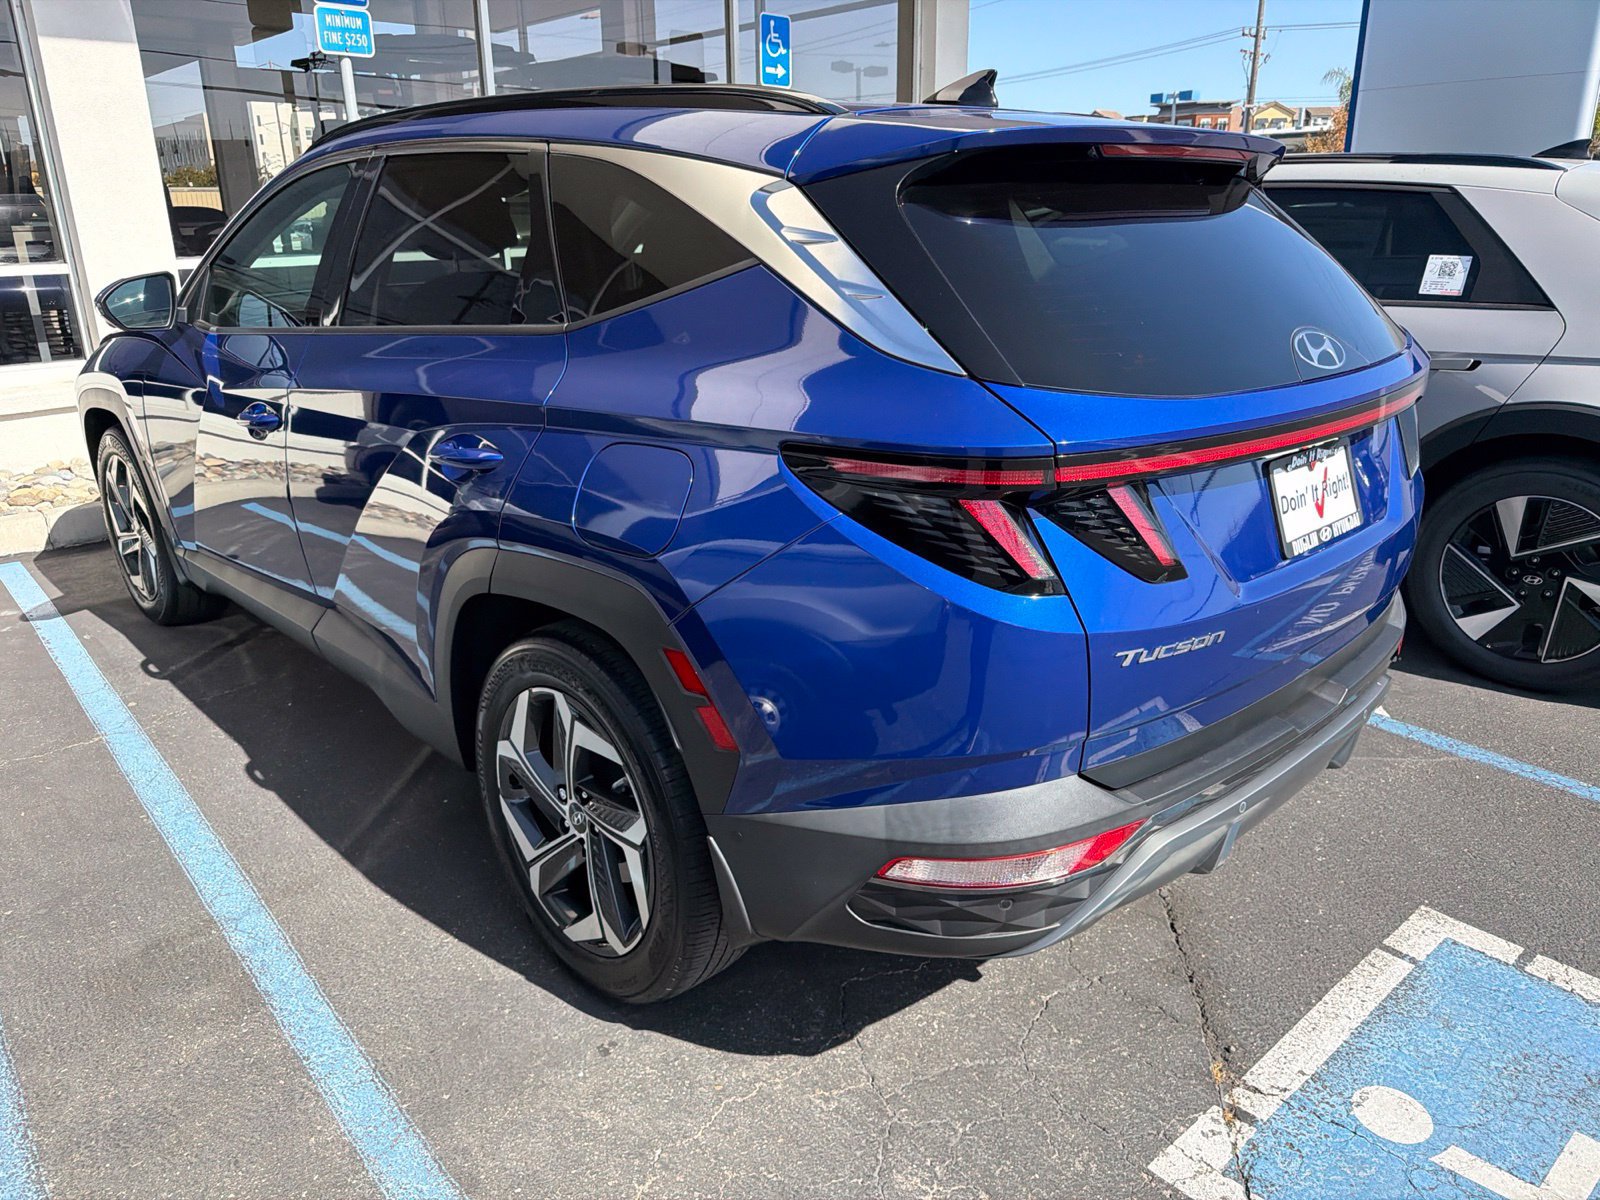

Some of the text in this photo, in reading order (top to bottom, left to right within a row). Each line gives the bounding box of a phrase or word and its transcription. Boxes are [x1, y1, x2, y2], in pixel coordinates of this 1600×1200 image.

[325, 14, 363, 30] MINIMUM
[323, 30, 368, 47] FINE $250
[1280, 471, 1350, 515] Doin' It Right!
